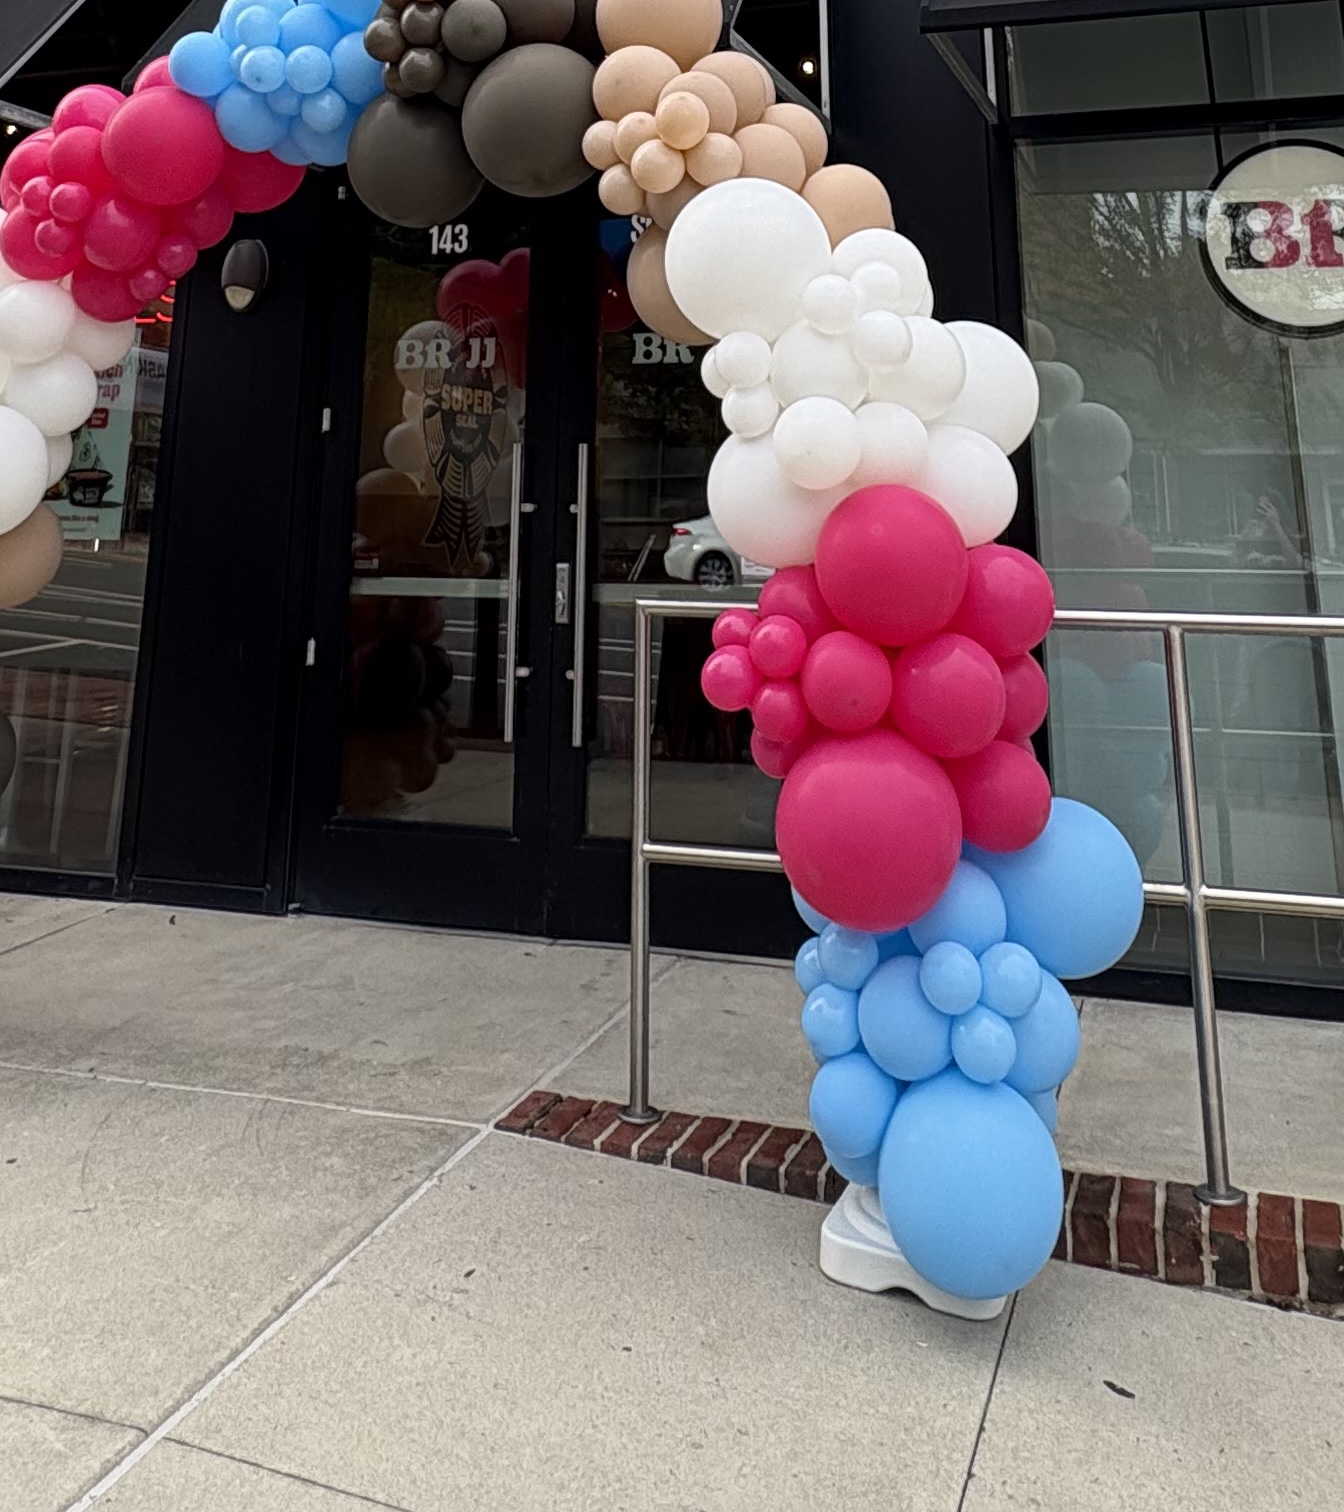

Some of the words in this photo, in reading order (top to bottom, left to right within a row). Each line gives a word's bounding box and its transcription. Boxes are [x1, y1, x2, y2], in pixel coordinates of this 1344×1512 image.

[429, 224, 469, 255] 143
[396, 338, 452, 369] BR
[466, 337, 496, 369] JJ
[632, 333, 695, 365] BR
[441, 384, 494, 416] SUPER
